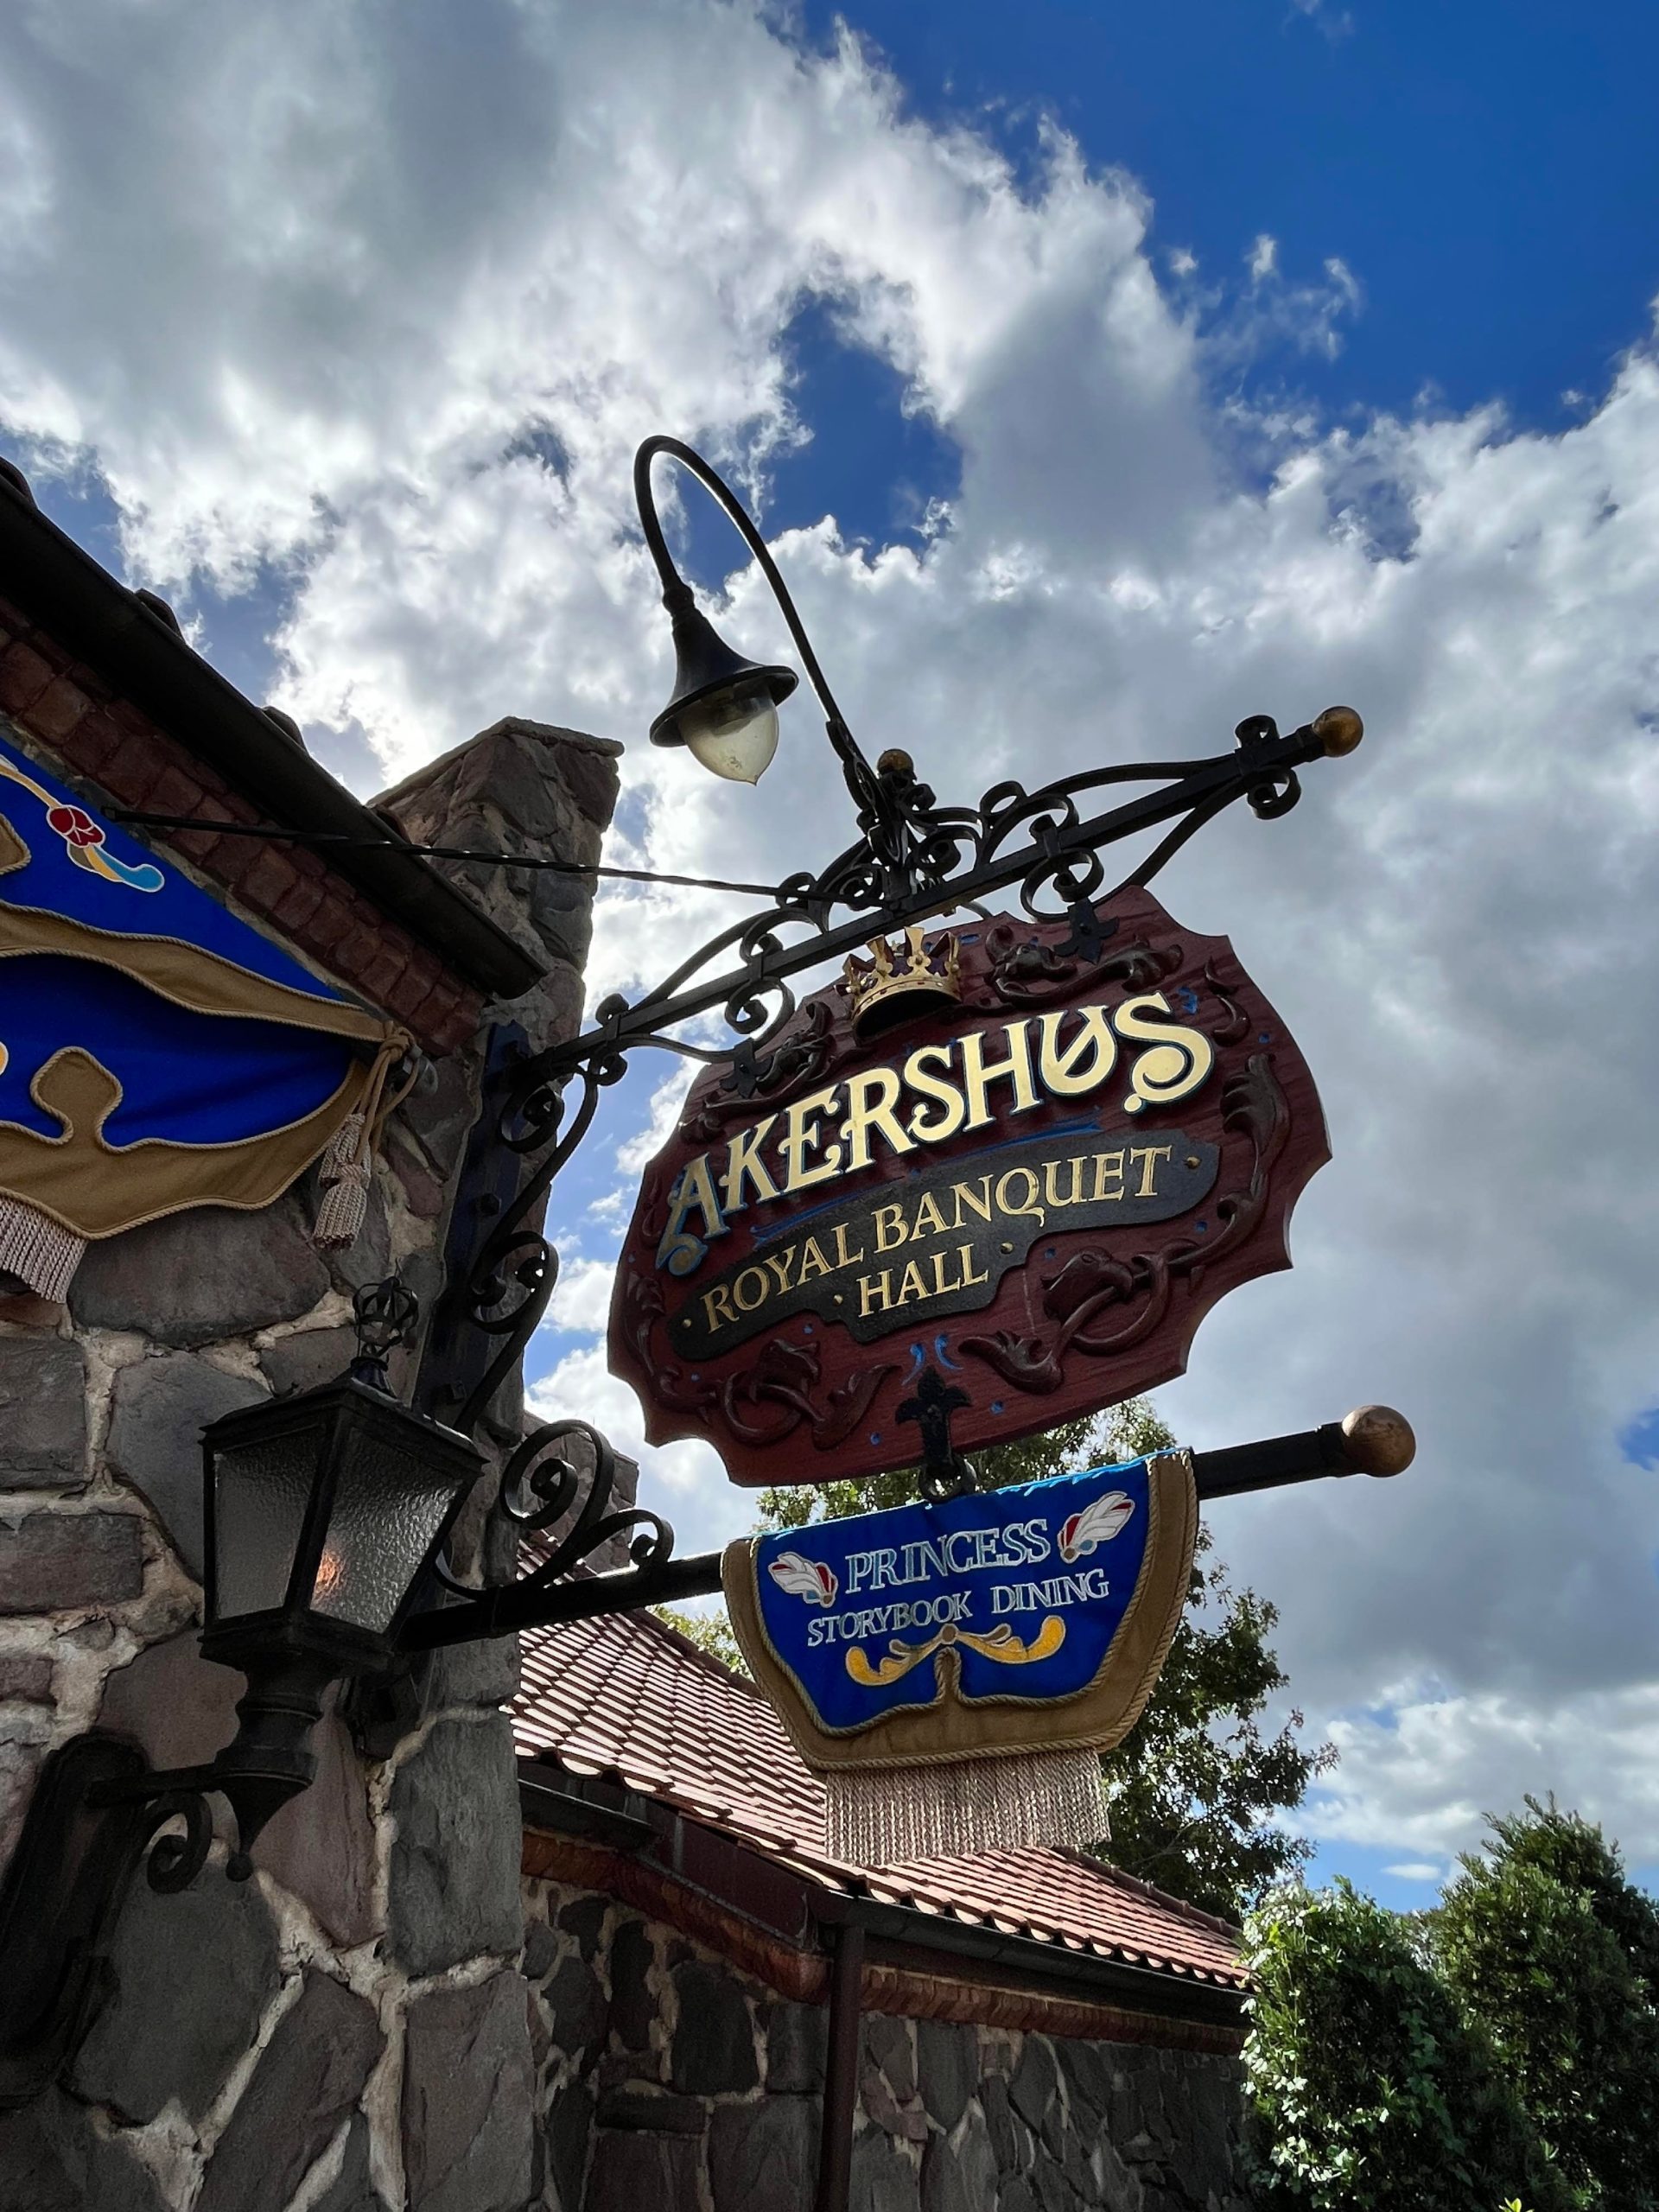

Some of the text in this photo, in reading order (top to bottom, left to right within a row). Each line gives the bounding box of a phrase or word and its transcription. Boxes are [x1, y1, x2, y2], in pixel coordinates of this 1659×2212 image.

[702, 1146, 1172, 1334] ROYAL BANQUET
[856, 1245, 988, 1319] HALL
[845, 1518, 1052, 1594] PRINCESS
[807, 1568, 1110, 1647] STORYBOOK DINING
